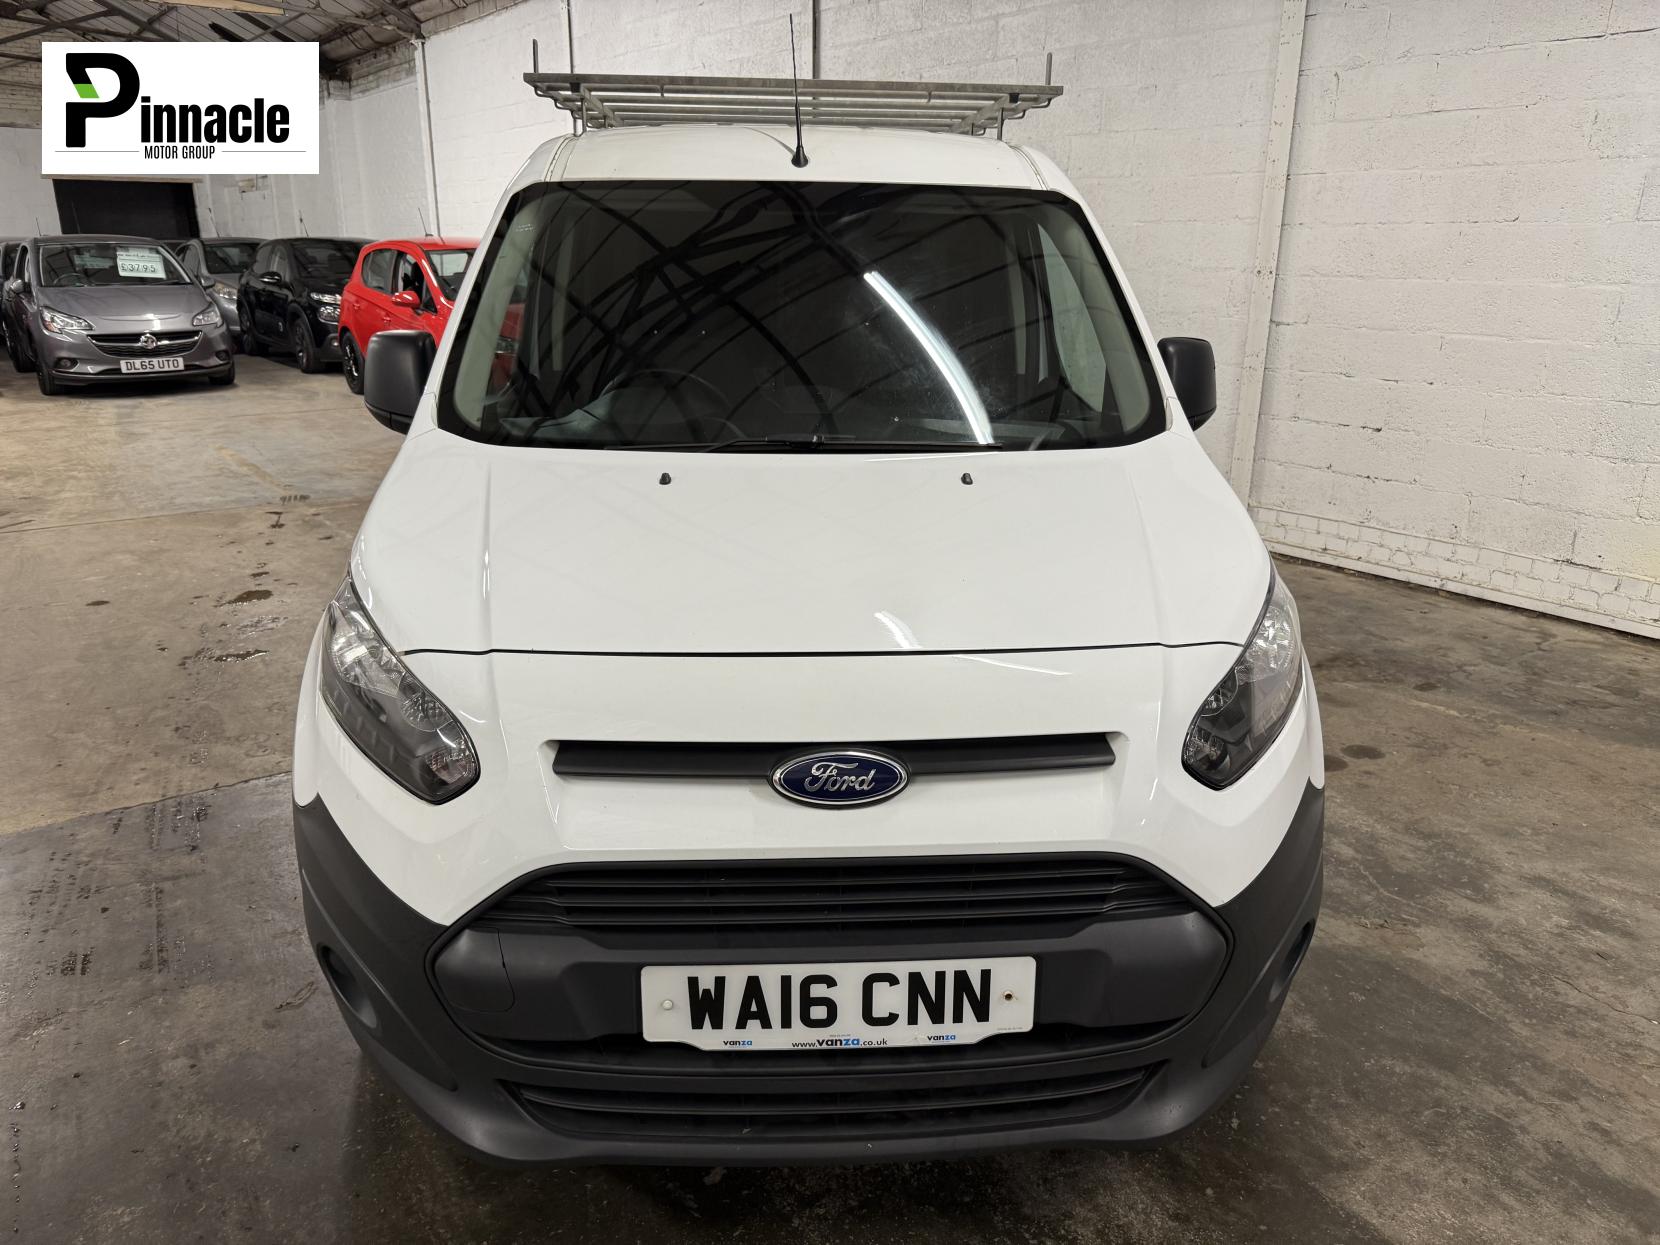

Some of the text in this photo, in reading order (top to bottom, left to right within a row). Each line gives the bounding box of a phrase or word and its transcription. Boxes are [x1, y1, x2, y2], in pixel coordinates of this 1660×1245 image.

[125, 360, 155, 370] DL65
[804, 762, 876, 792] Ford
[687, 969, 992, 1030] WA16 CNN
[792, 1038, 888, 1048] www.vanza.co.uk
